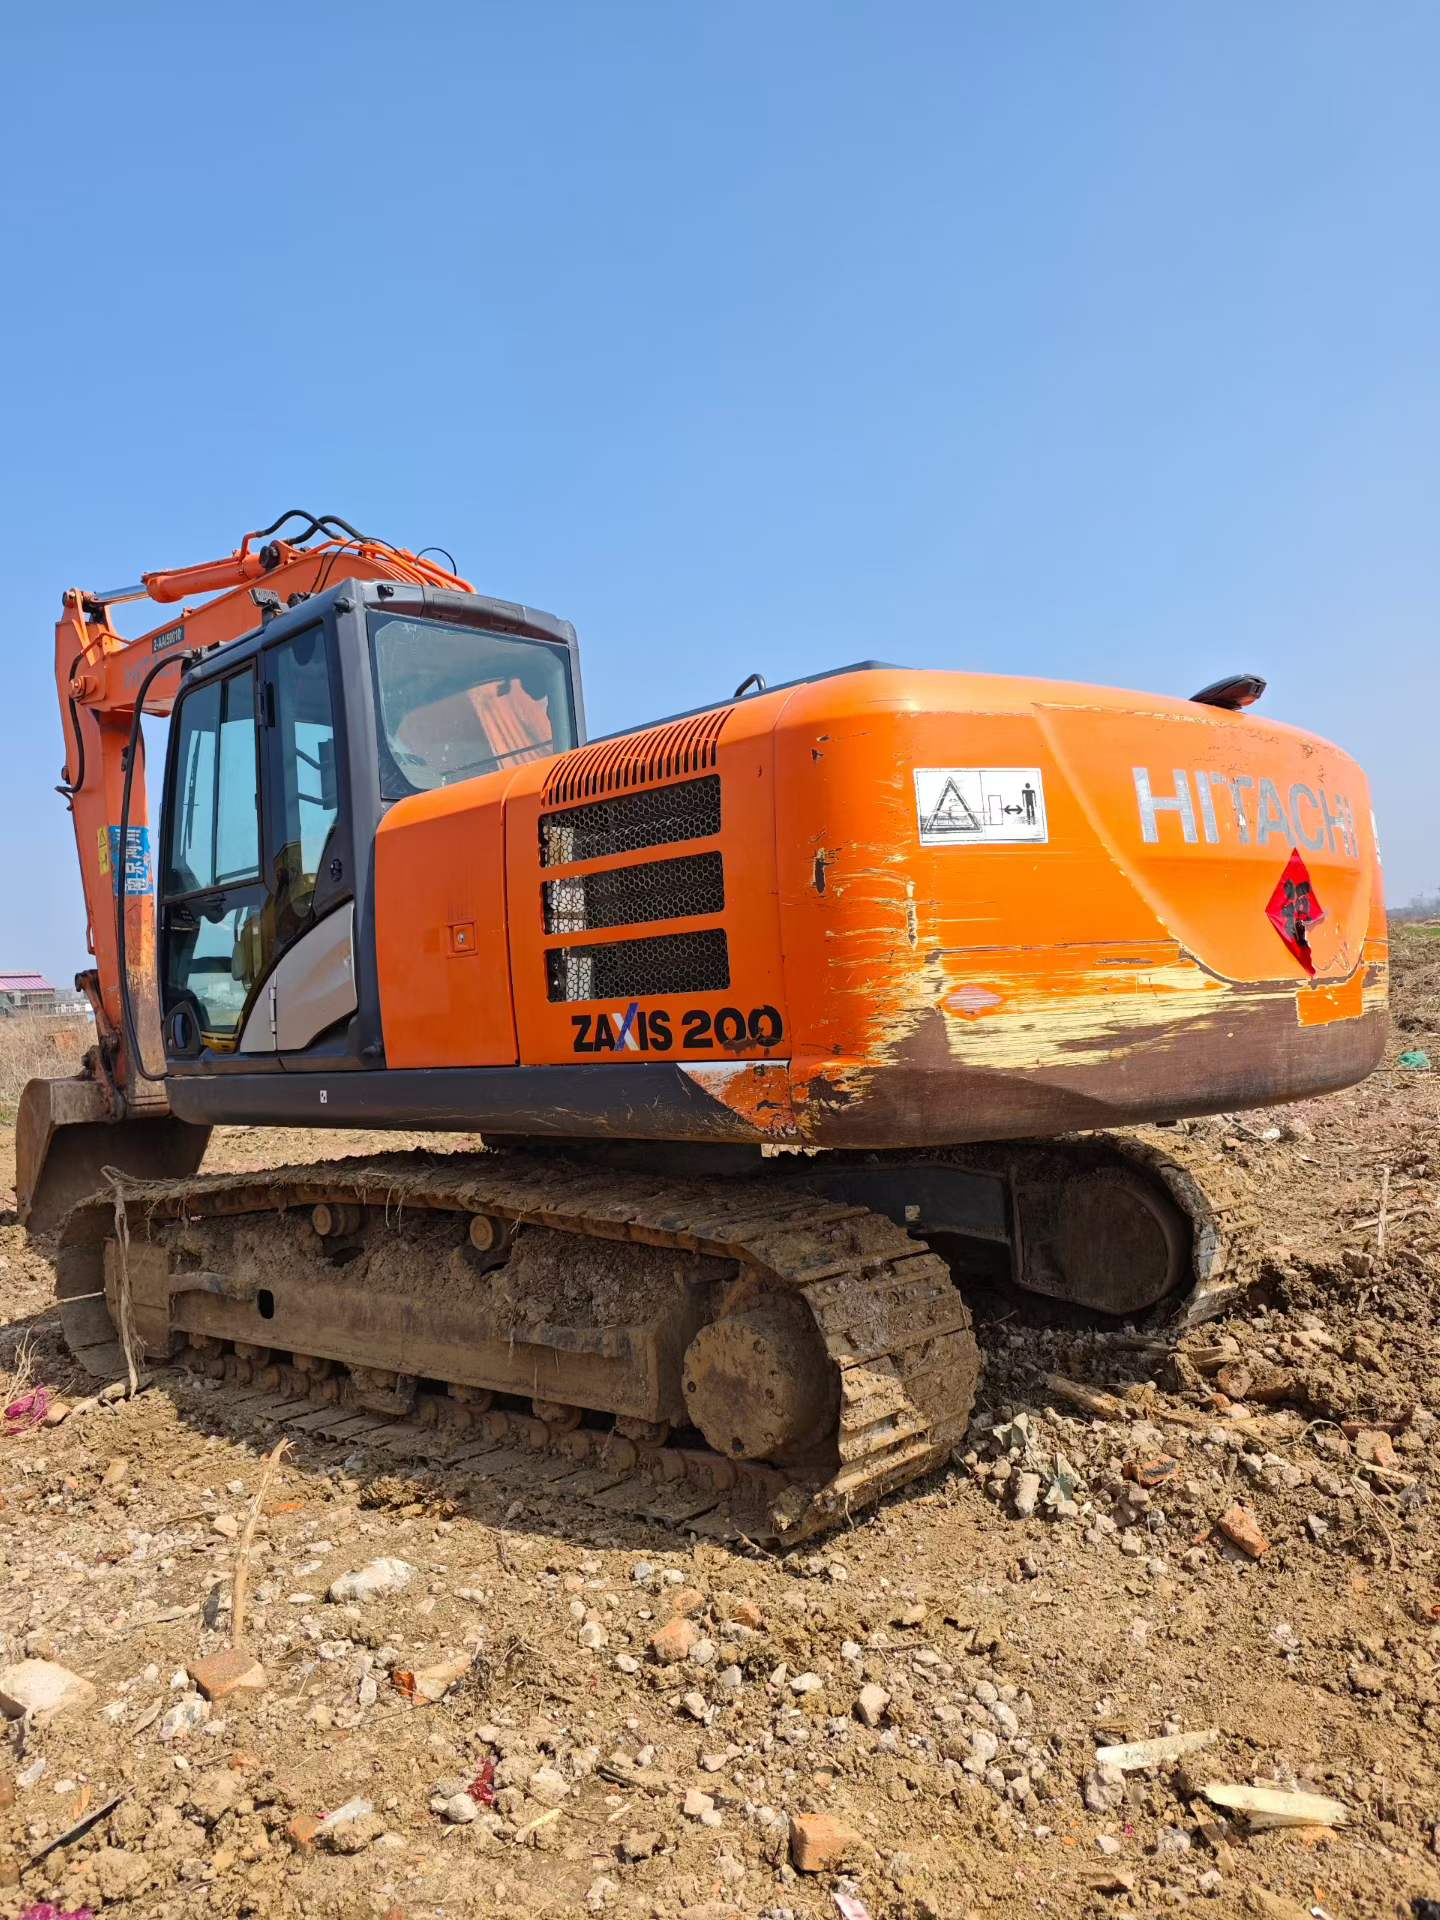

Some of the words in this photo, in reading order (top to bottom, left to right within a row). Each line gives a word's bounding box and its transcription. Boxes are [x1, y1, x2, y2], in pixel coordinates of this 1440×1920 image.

[1131, 766, 1359, 859] HITACHI
[571, 1002, 673, 1052] ZAXIS
[681, 1004, 783, 1050] 200
